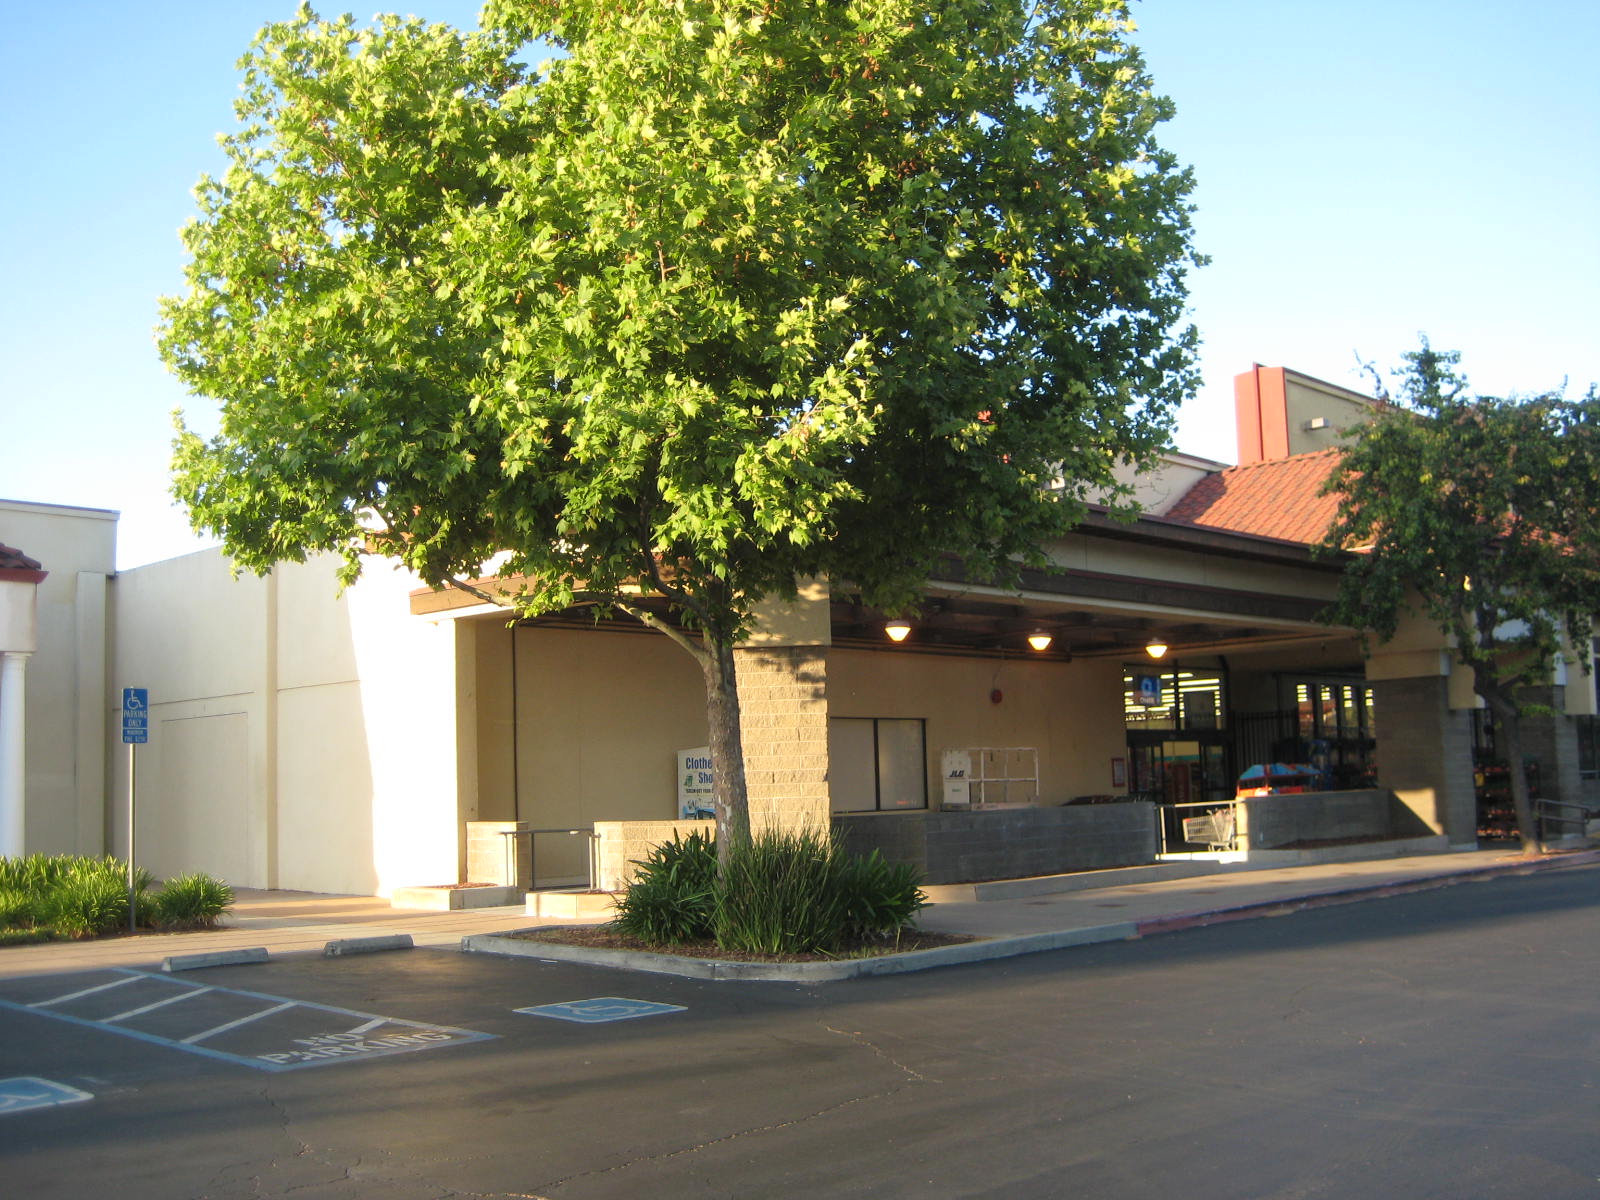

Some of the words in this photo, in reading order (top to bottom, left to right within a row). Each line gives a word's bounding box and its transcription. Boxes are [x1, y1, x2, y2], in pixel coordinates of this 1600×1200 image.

[124, 710, 147, 718] PARKING
[128, 719, 142, 727] ONLY
[687, 758, 713, 769] Clothe
[698, 772, 713, 783] Sho
[293, 1032, 365, 1046] NO
[256, 1031, 451, 1064] PARKING
